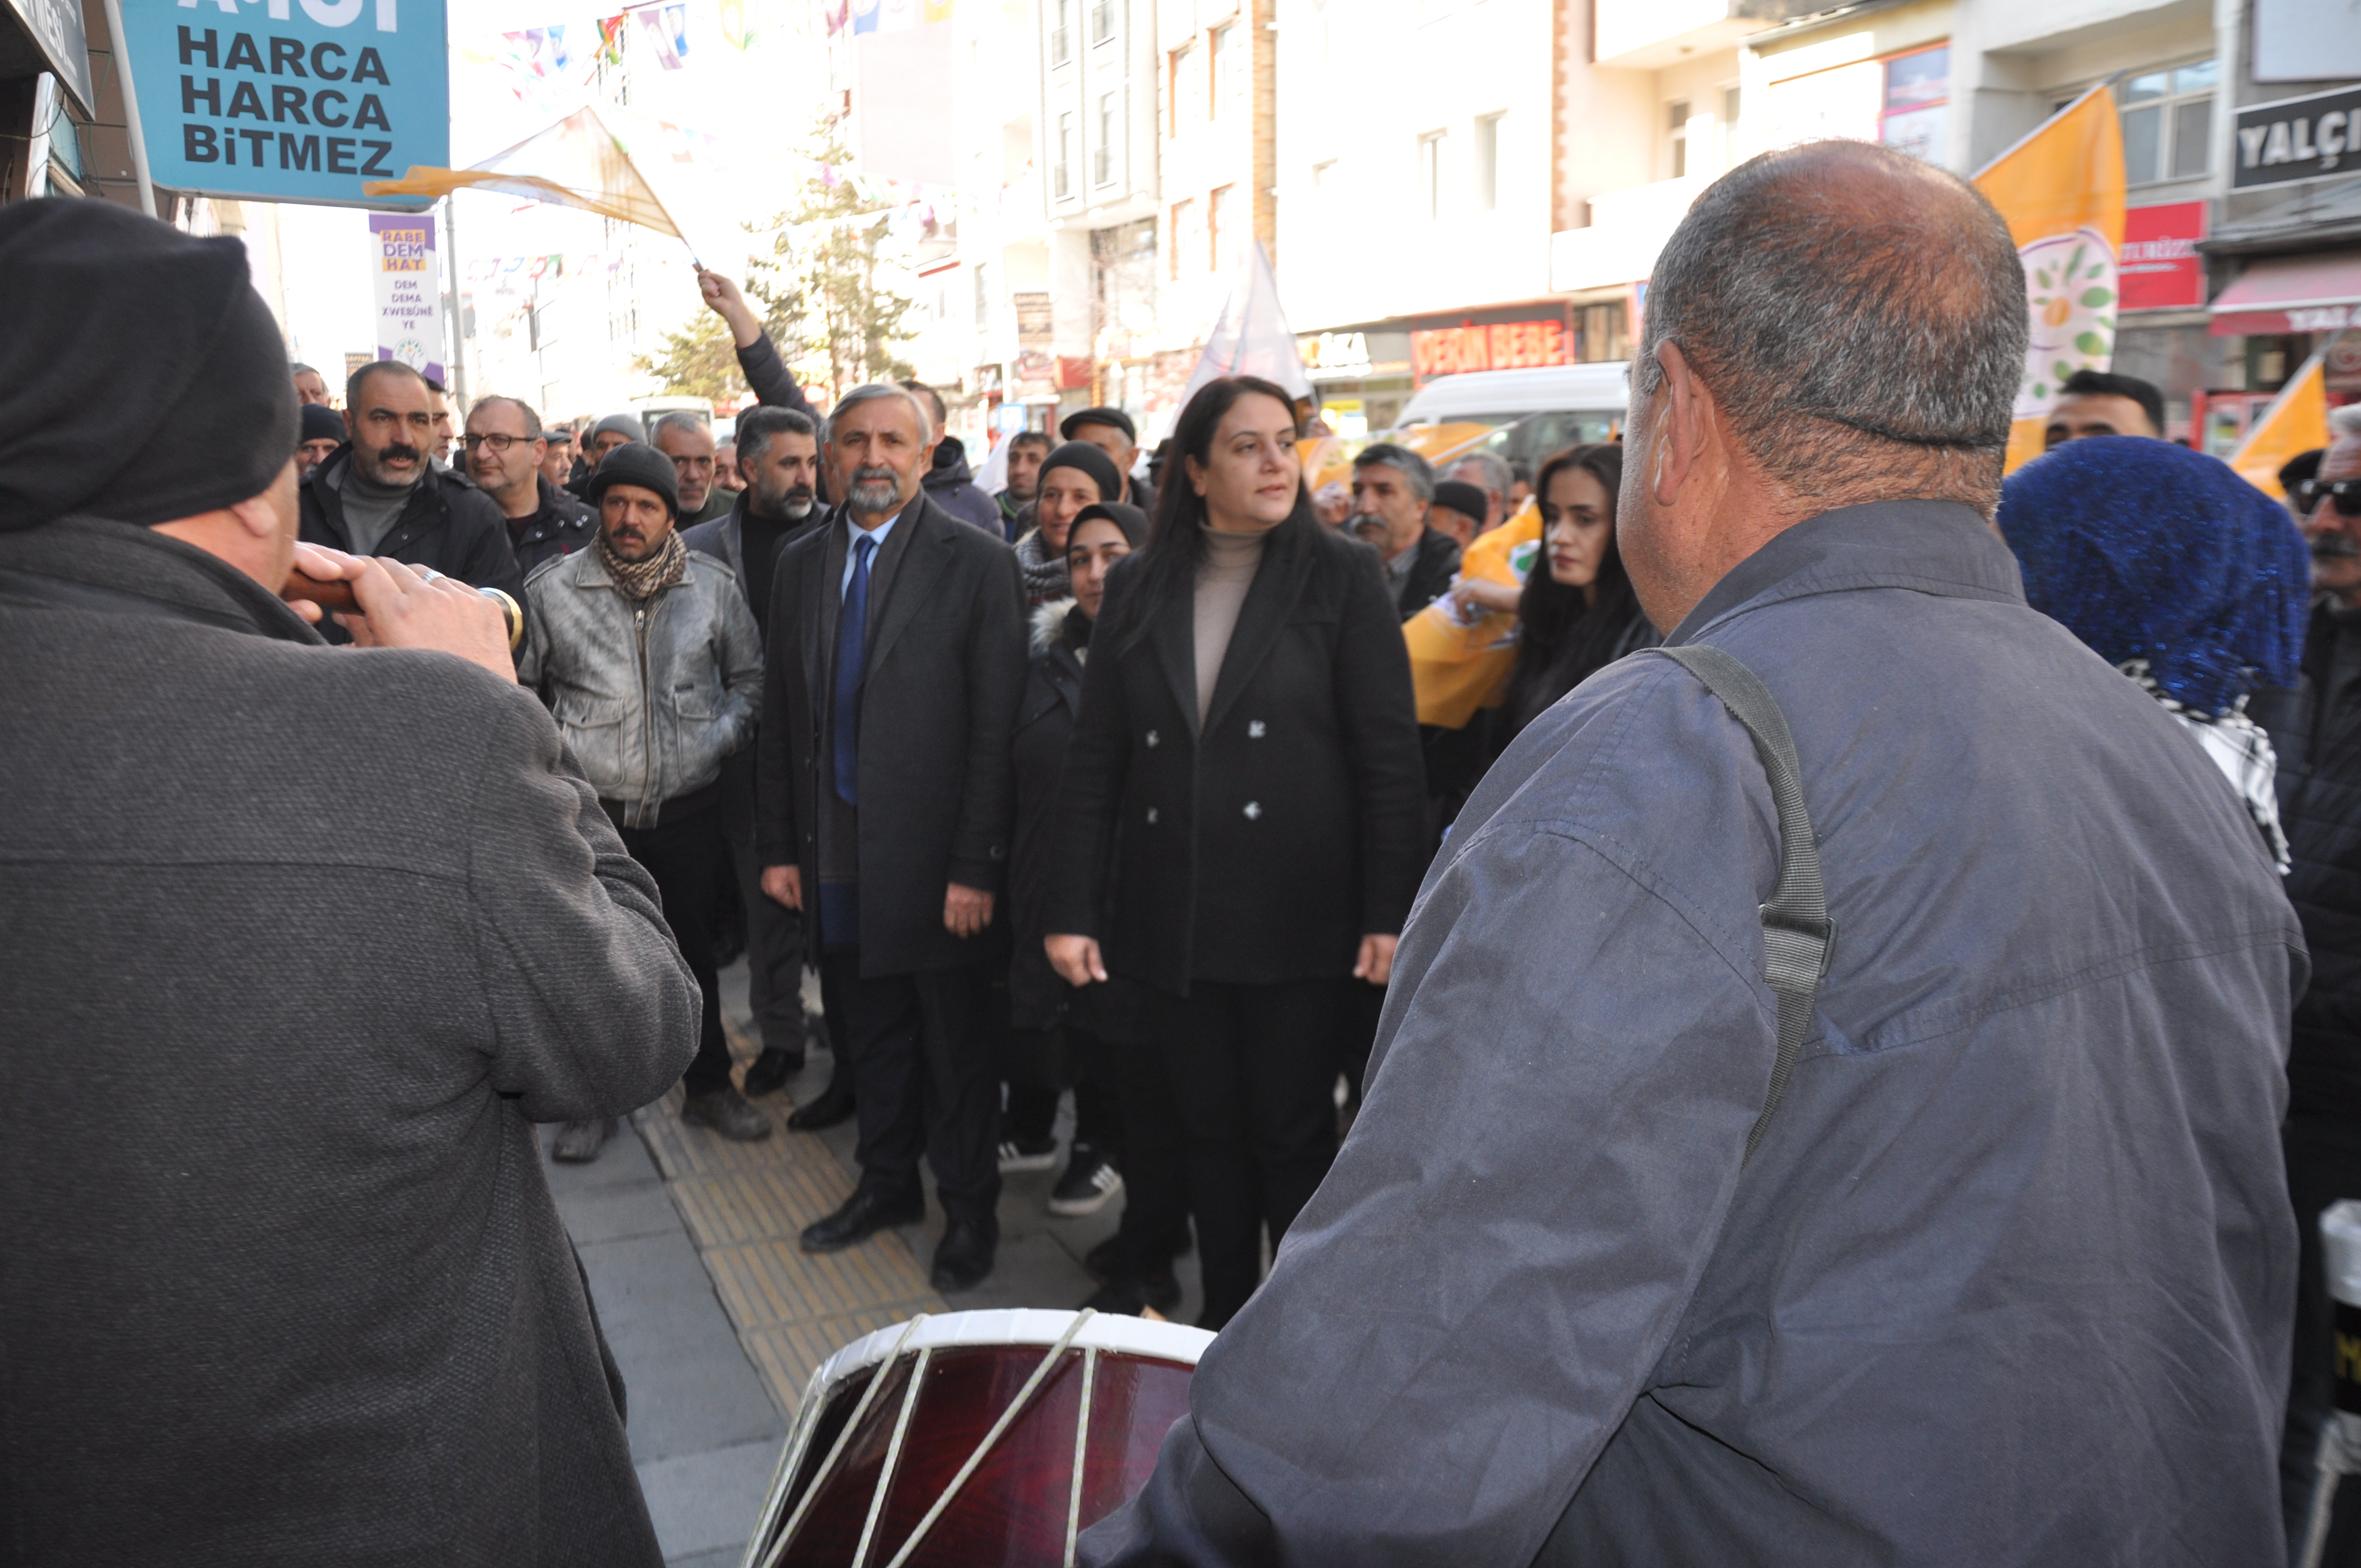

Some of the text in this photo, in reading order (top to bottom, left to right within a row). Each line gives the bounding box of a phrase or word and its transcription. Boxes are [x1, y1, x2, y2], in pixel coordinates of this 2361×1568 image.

[177, 25, 391, 85] HARCA
[181, 74, 391, 131] HARCA
[383, 231, 423, 243] RABE
[384, 243, 424, 258] DEM
[387, 259, 423, 271] HAT
[394, 280, 417, 290] DEM
[391, 293, 422, 303] DEMA
[401, 319, 416, 330] YE
[1490, 320, 1565, 369] BEBE
